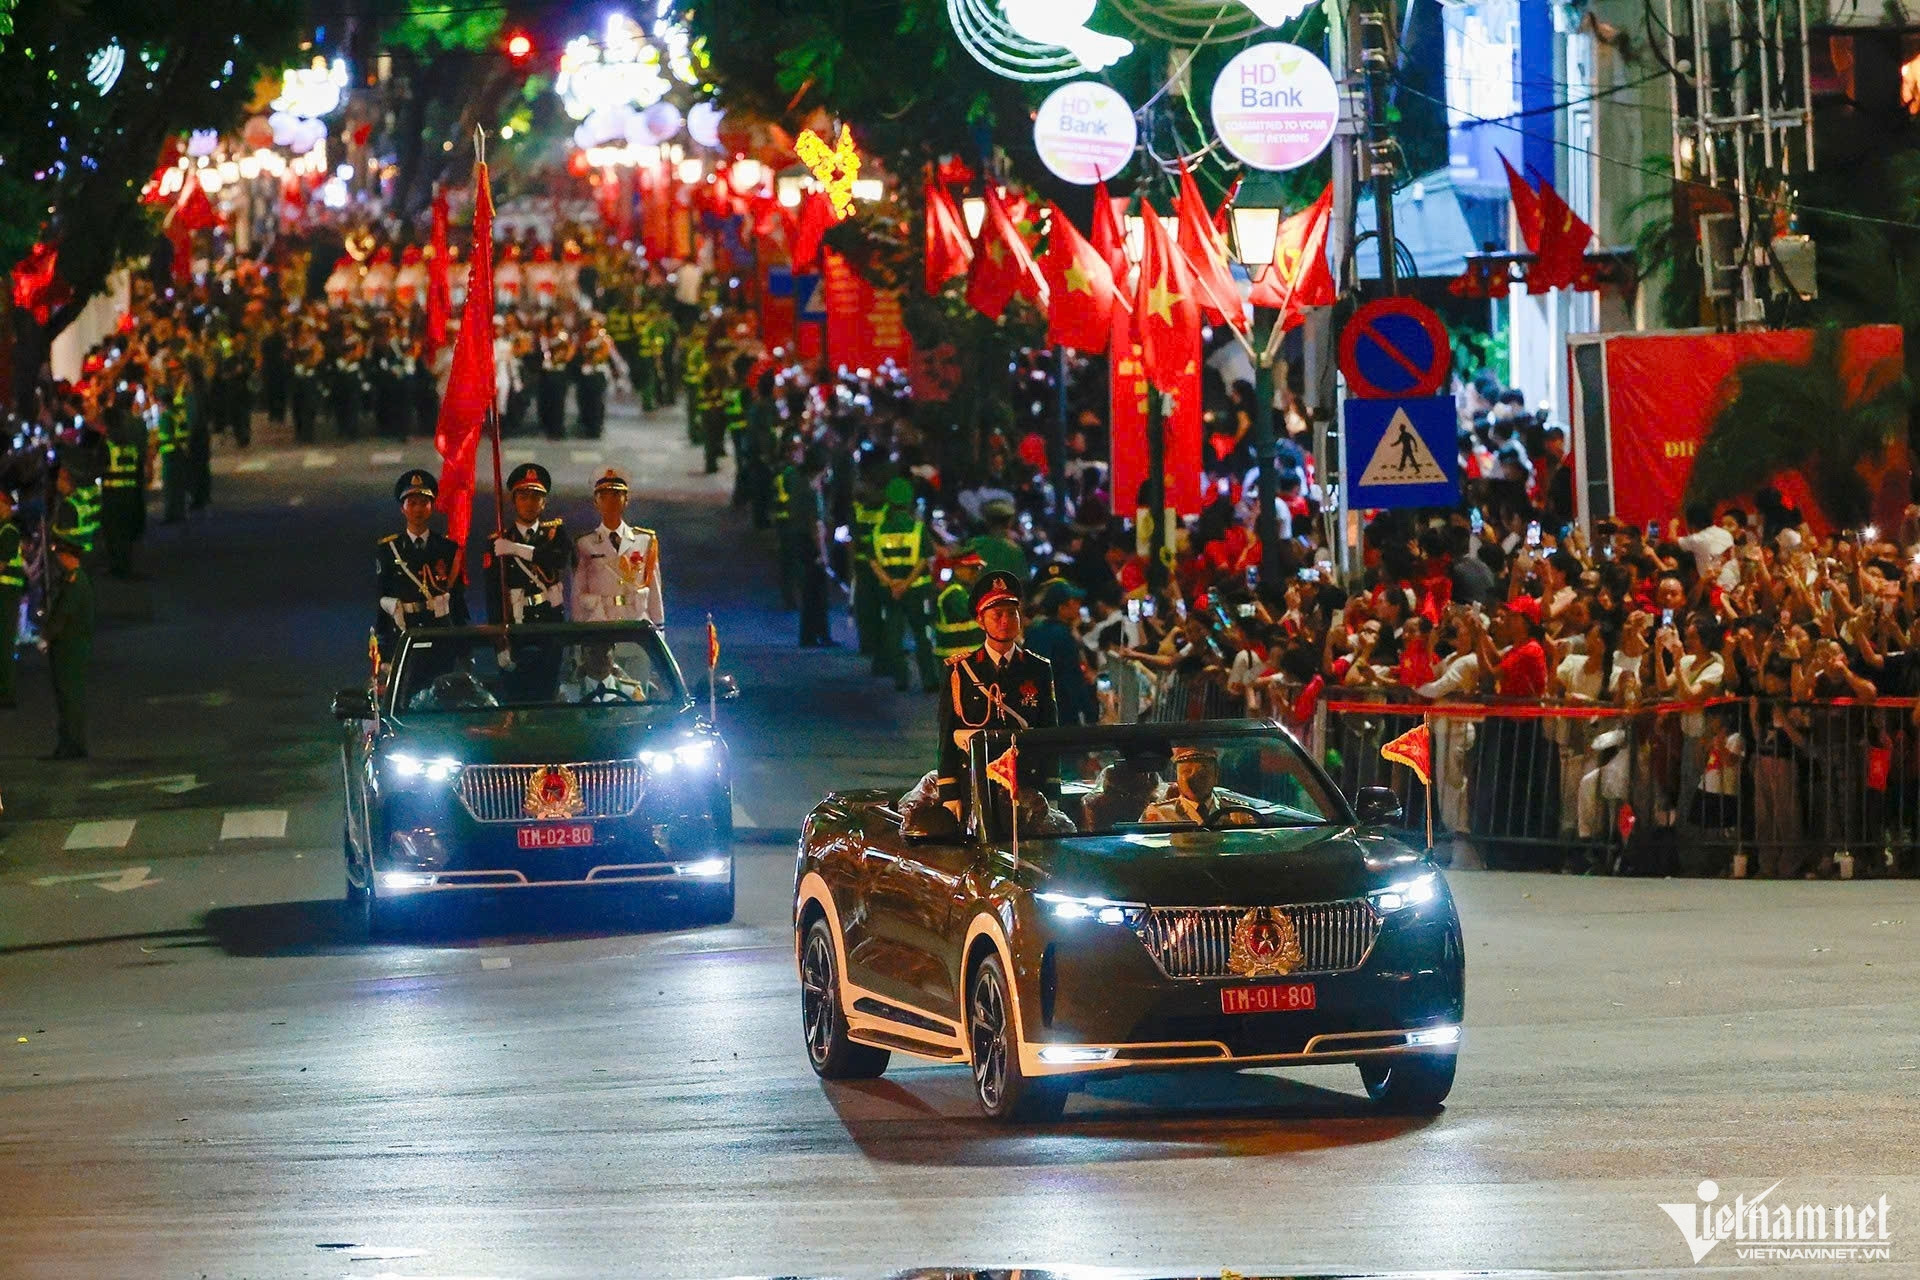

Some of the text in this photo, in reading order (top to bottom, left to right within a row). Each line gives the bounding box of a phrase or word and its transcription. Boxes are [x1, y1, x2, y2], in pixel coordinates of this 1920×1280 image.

[1241, 64, 1276, 84] HD
[1061, 97, 1090, 114] HD
[1241, 87, 1303, 107] Bank
[1060, 114, 1108, 135] Bank
[521, 827, 591, 846] TM-02-80
[1225, 986, 1312, 1010] TM-01-80
